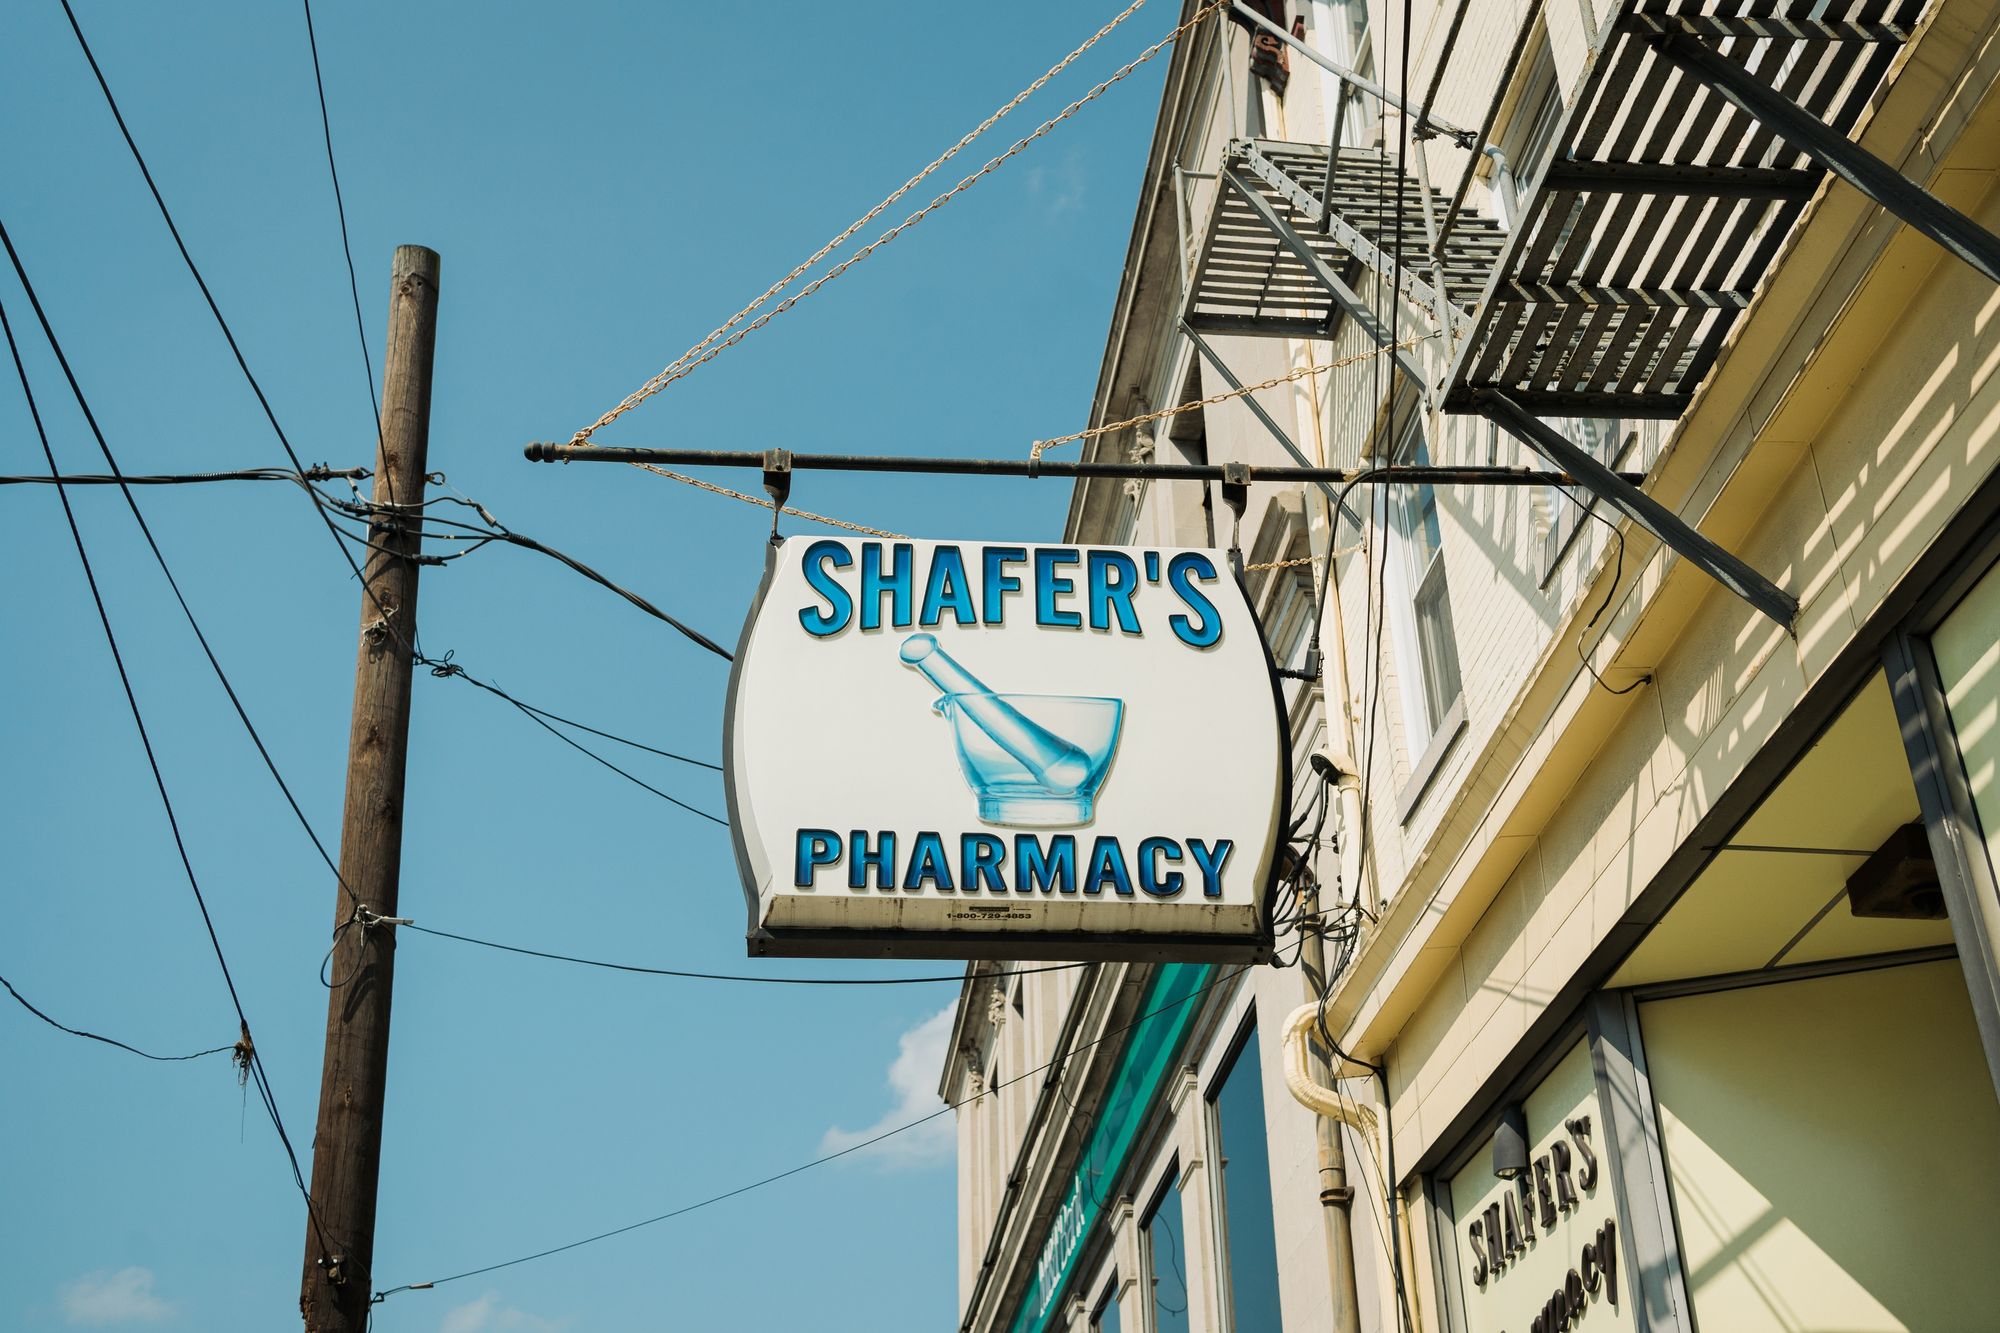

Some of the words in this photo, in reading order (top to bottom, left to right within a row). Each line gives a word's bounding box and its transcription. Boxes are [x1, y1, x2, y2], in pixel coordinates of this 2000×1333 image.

[798, 540, 1224, 649] SHAFER'S
[794, 828, 1234, 898] PHARMACY
[1469, 1115, 1598, 1286] SHAFER'S
